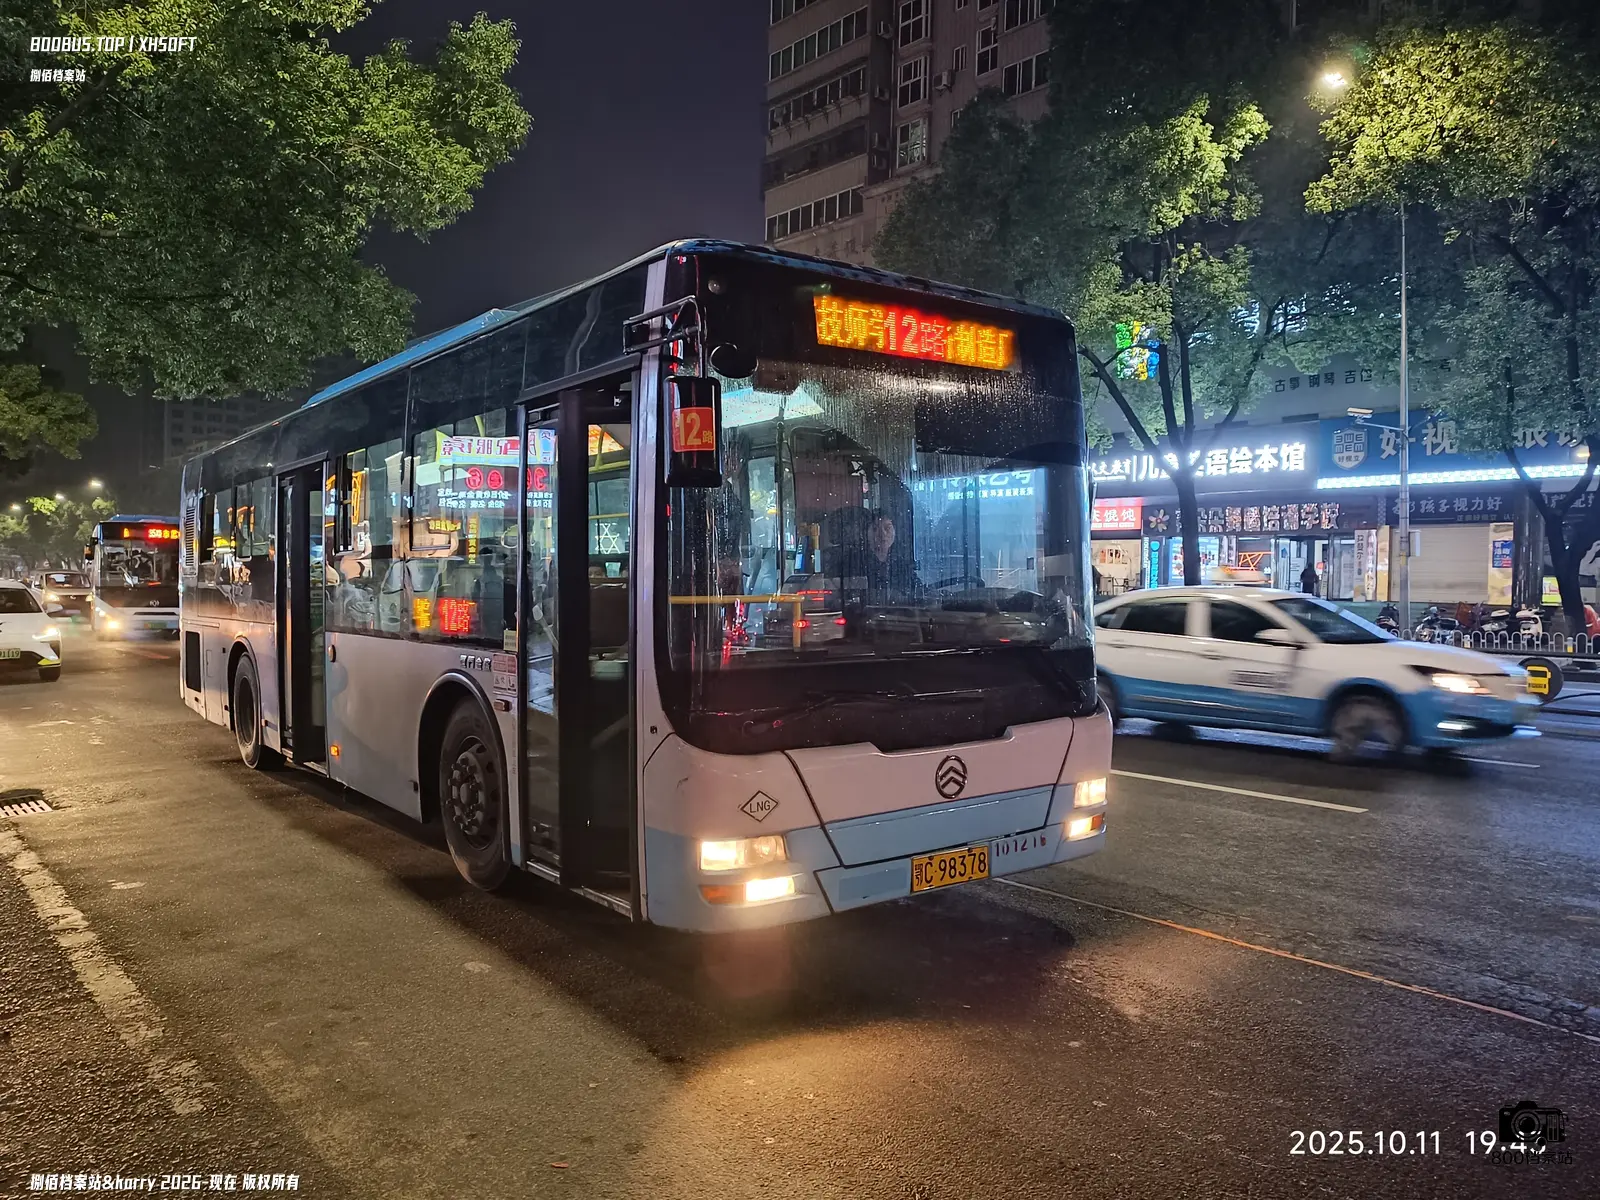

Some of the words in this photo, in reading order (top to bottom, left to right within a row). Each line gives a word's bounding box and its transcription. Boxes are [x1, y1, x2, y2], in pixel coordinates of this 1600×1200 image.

[1309, 372, 1335, 388] 钢琴
[678, 412, 713, 446] 12路
[749, 799, 771, 814] LNG
